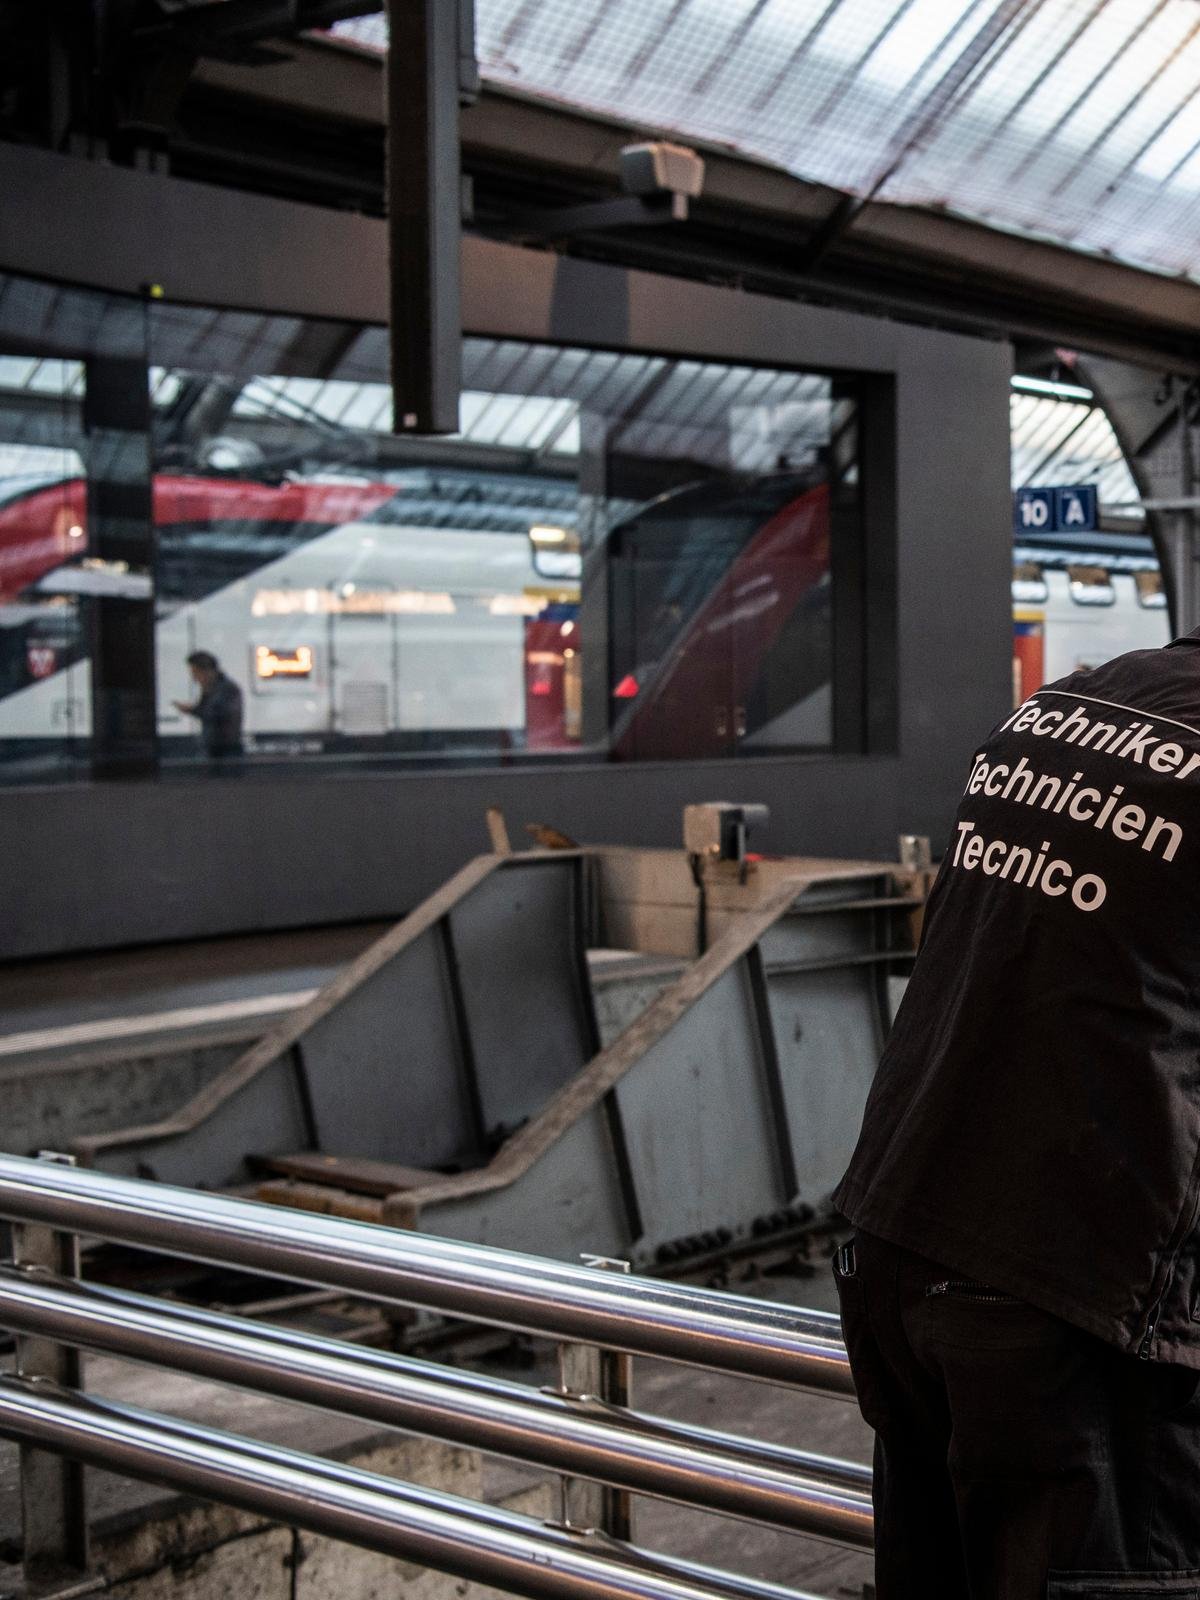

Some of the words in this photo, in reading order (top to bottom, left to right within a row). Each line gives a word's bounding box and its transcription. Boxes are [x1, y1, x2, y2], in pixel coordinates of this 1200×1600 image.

[1021, 498, 1048, 527] 10
[1065, 498, 1086, 525] A
[952, 821, 1107, 912] Tecnico
